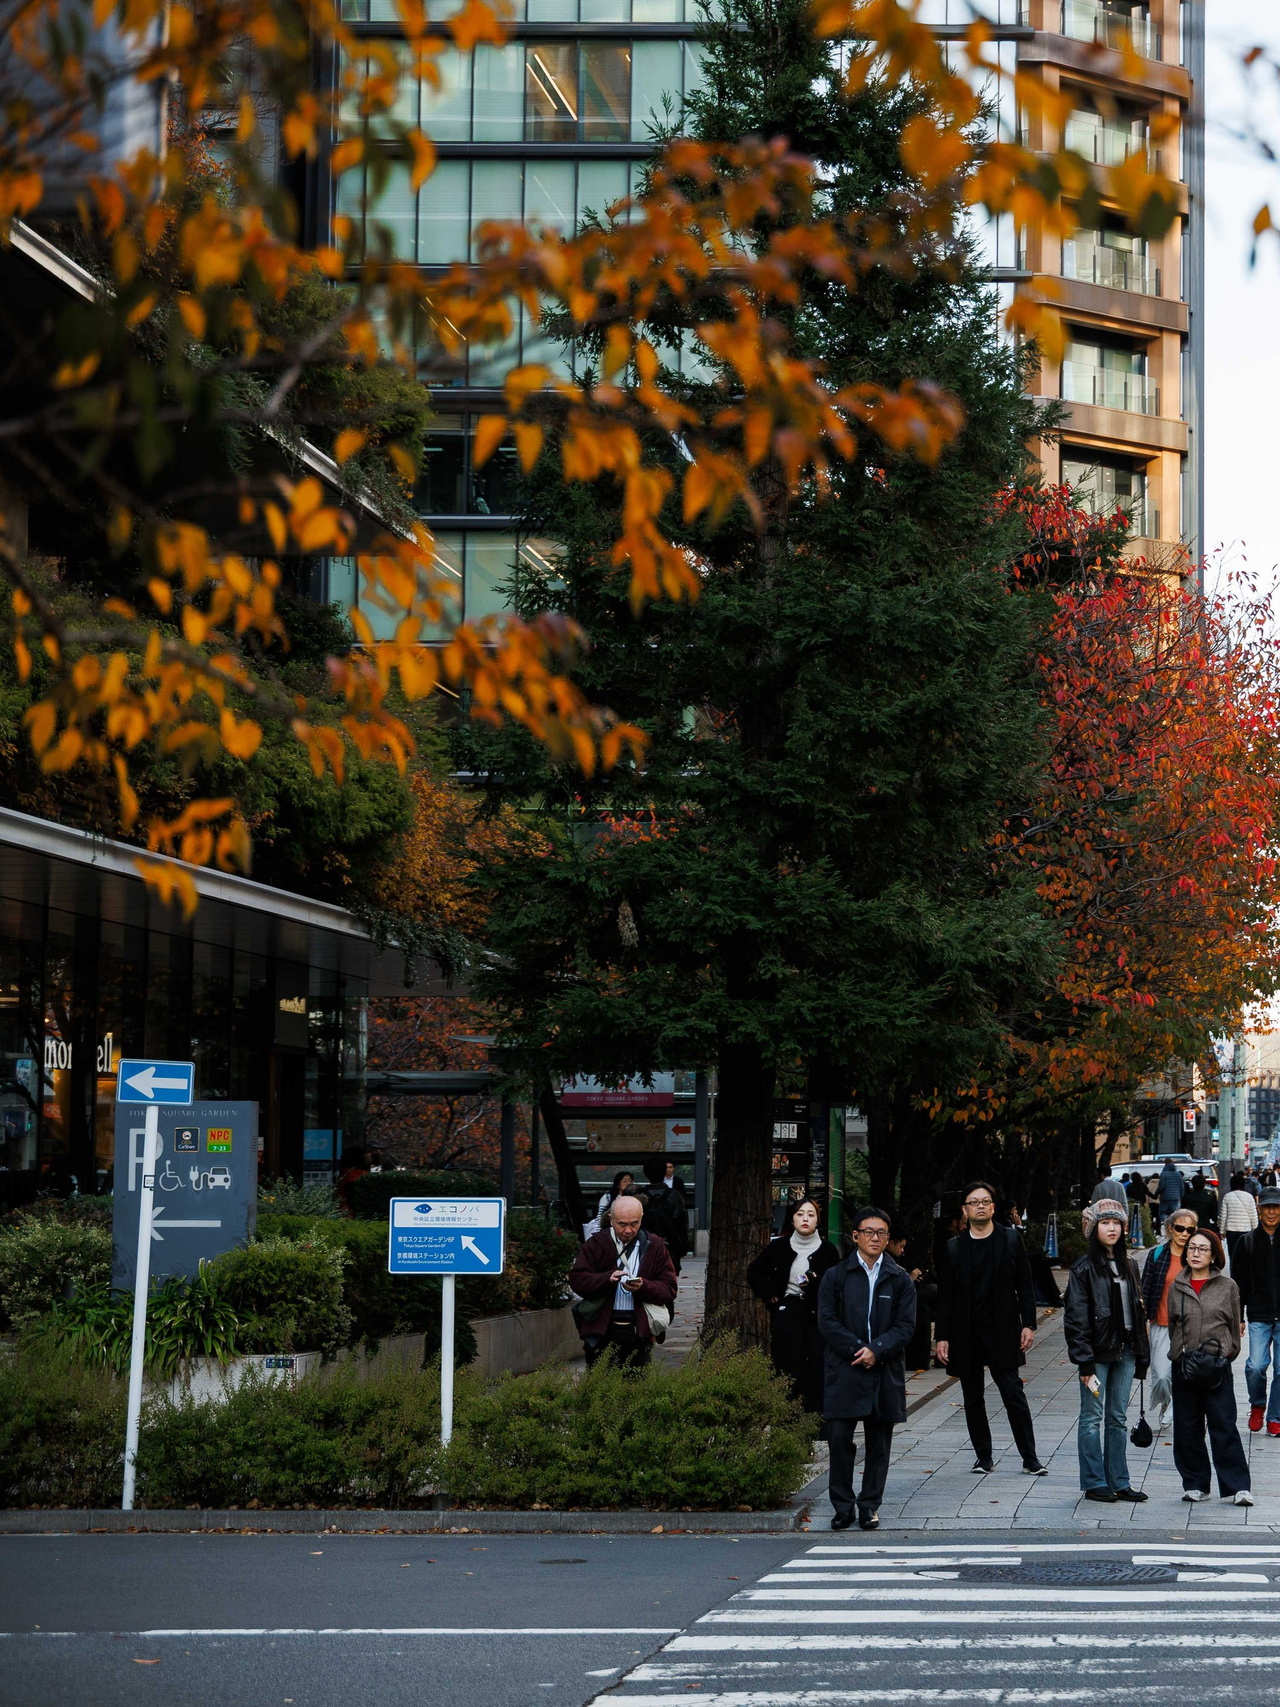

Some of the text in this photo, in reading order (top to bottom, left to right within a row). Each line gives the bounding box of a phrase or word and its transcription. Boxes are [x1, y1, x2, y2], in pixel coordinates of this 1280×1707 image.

[209, 1130, 230, 1141] NPC
[438, 1205, 480, 1213] エコノバ
